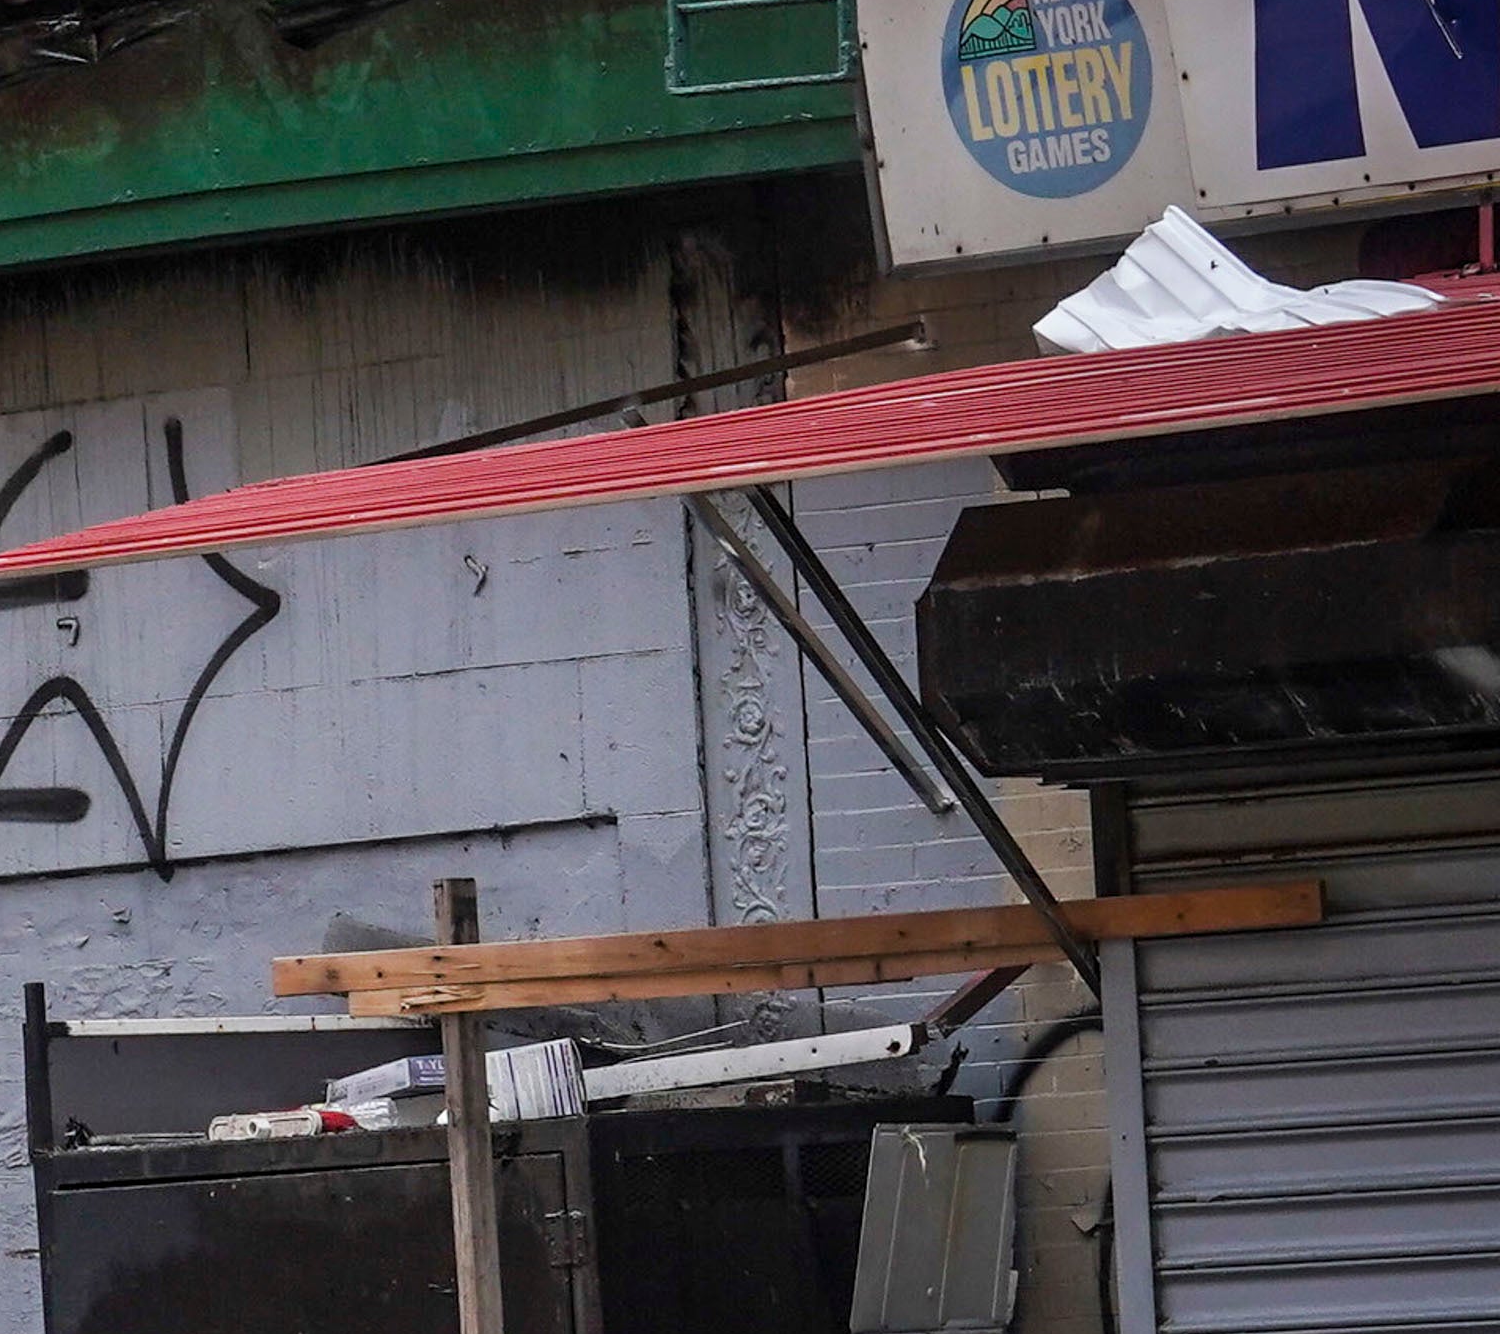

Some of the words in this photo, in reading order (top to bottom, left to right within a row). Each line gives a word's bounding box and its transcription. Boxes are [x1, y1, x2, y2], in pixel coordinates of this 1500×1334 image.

[1036, 0, 1113, 48] YORK
[960, 42, 1133, 142] LOTTERY
[1007, 128, 1112, 174] GAMES
